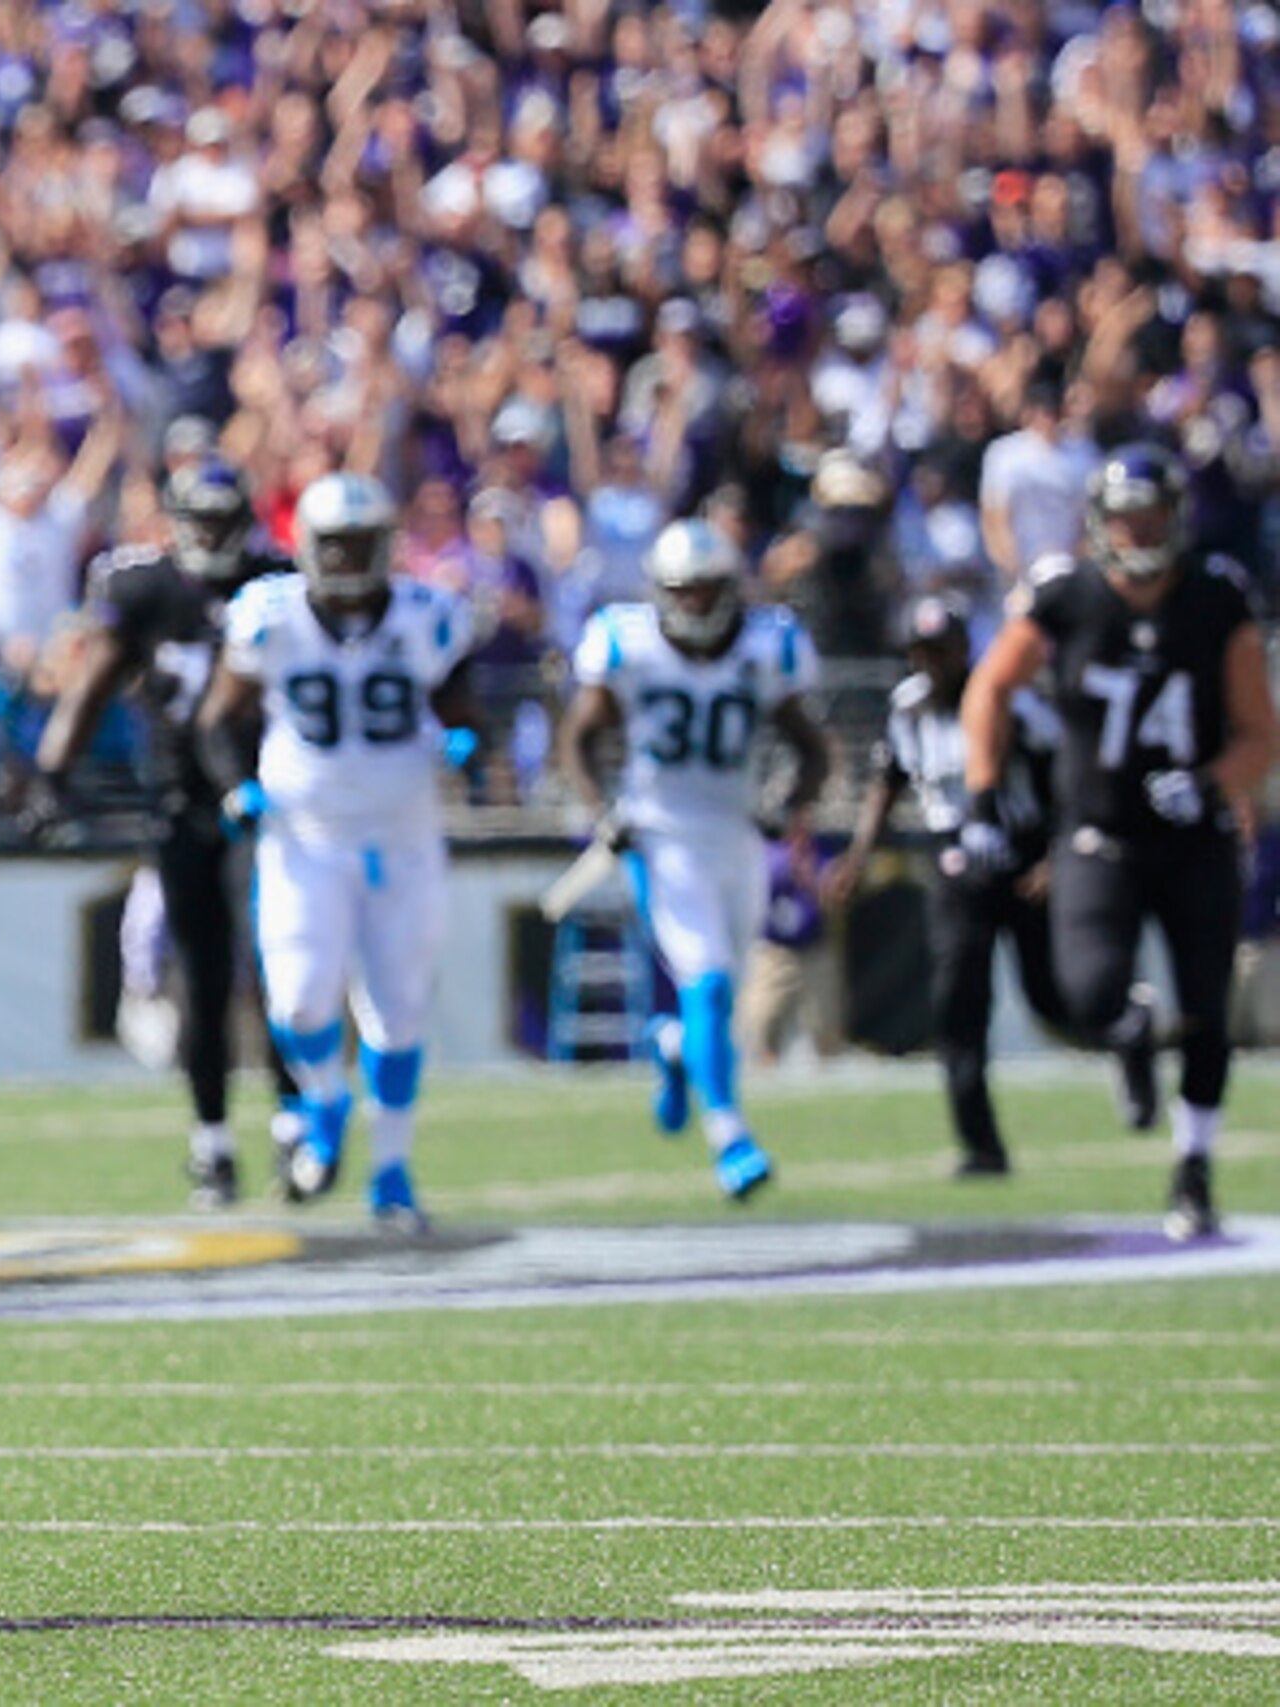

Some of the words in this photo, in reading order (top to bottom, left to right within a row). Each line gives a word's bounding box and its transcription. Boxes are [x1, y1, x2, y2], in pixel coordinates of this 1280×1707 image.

[286, 670, 418, 747] 99
[639, 686, 756, 772] 30
[1081, 663, 1196, 768] 74
